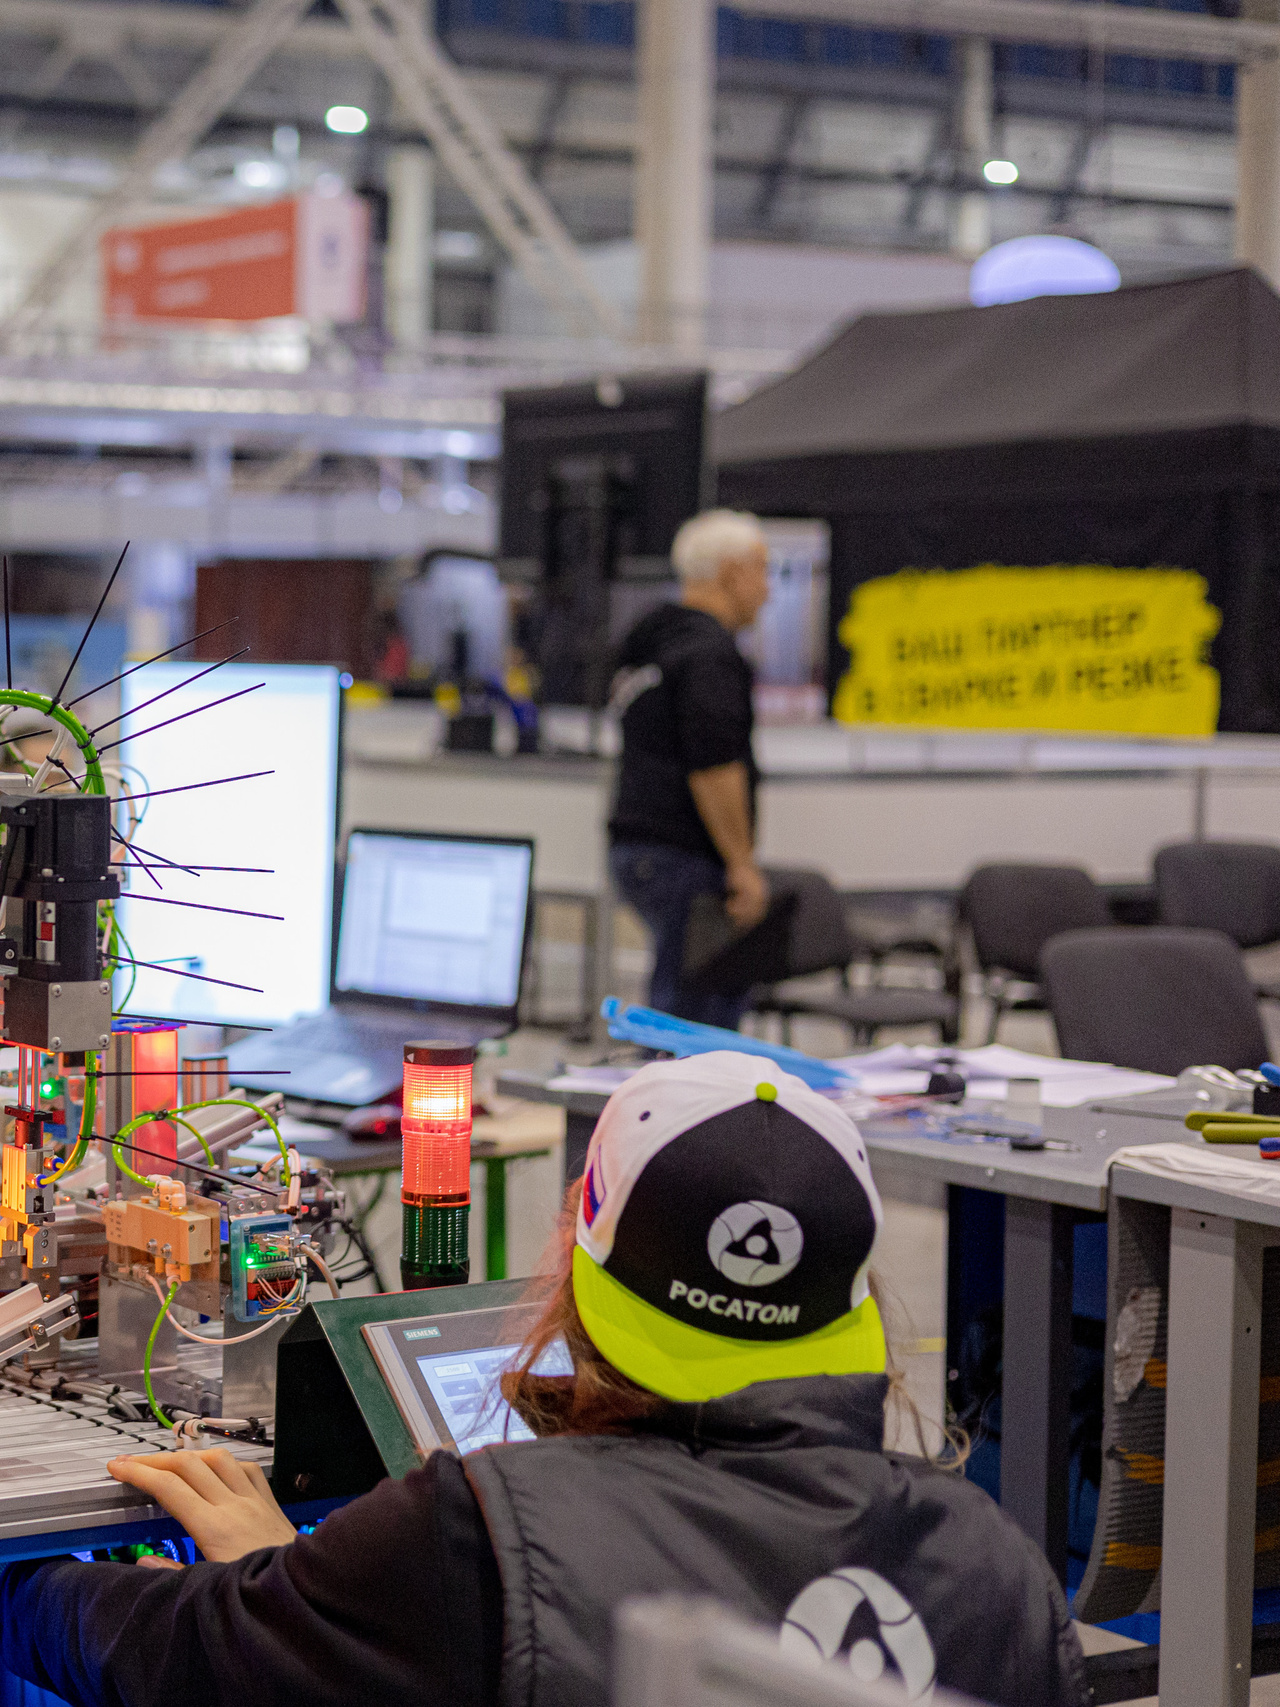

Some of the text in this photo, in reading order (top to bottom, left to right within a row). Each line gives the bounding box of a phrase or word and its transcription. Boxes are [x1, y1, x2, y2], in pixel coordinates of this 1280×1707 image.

[979, 603, 1146, 656] ПАРТНЕР
[1067, 650, 1186, 700] РЕЗКЕ
[669, 1279, 800, 1325] РОСАТОМ
[405, 1328, 439, 1339] SIEMENS
